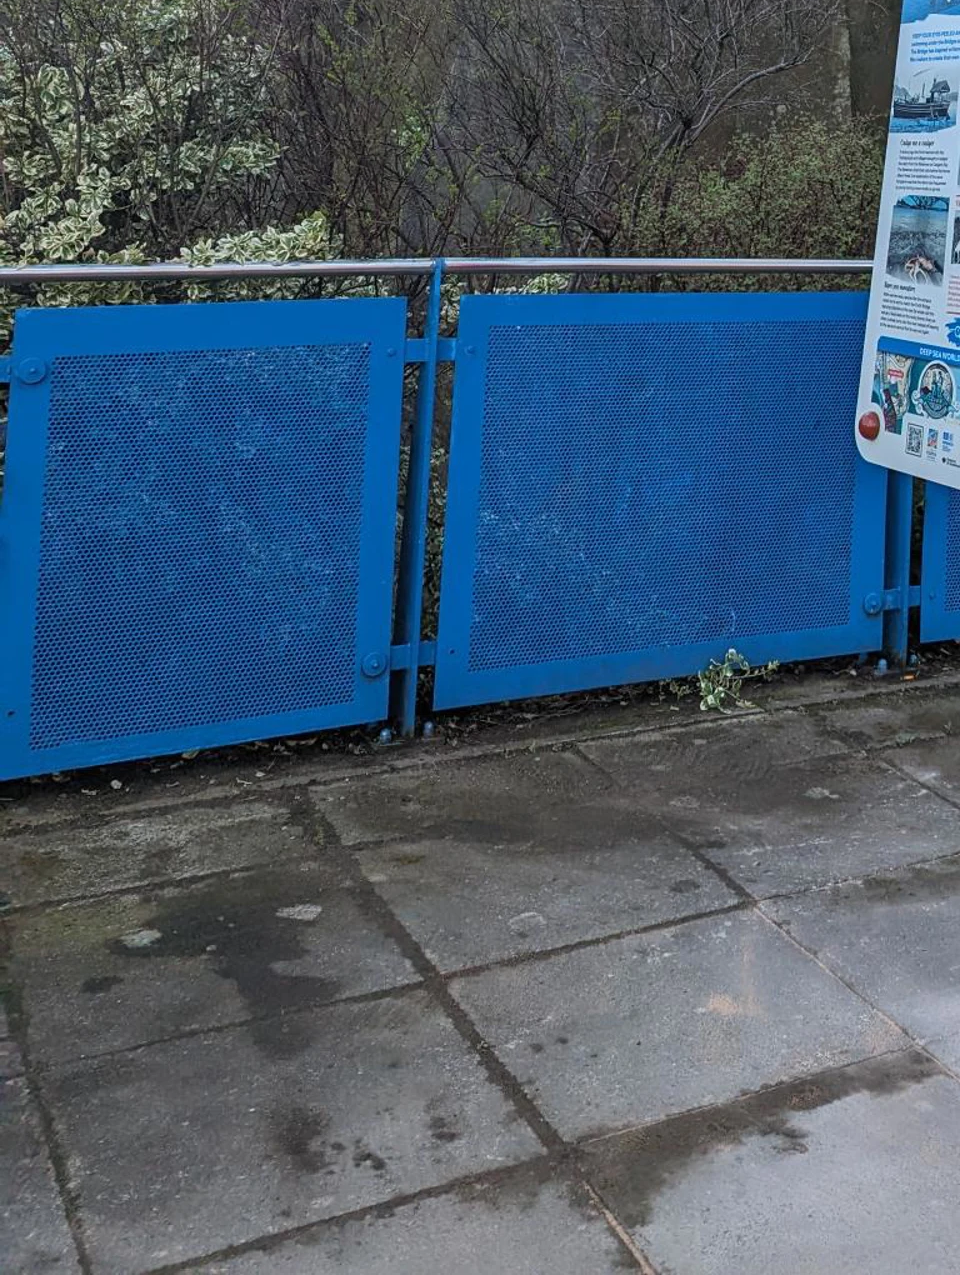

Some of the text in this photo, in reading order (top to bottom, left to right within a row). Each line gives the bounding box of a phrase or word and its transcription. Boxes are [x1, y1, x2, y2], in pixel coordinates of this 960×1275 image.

[919, 346, 960, 362] DEEP SEA WORLD
